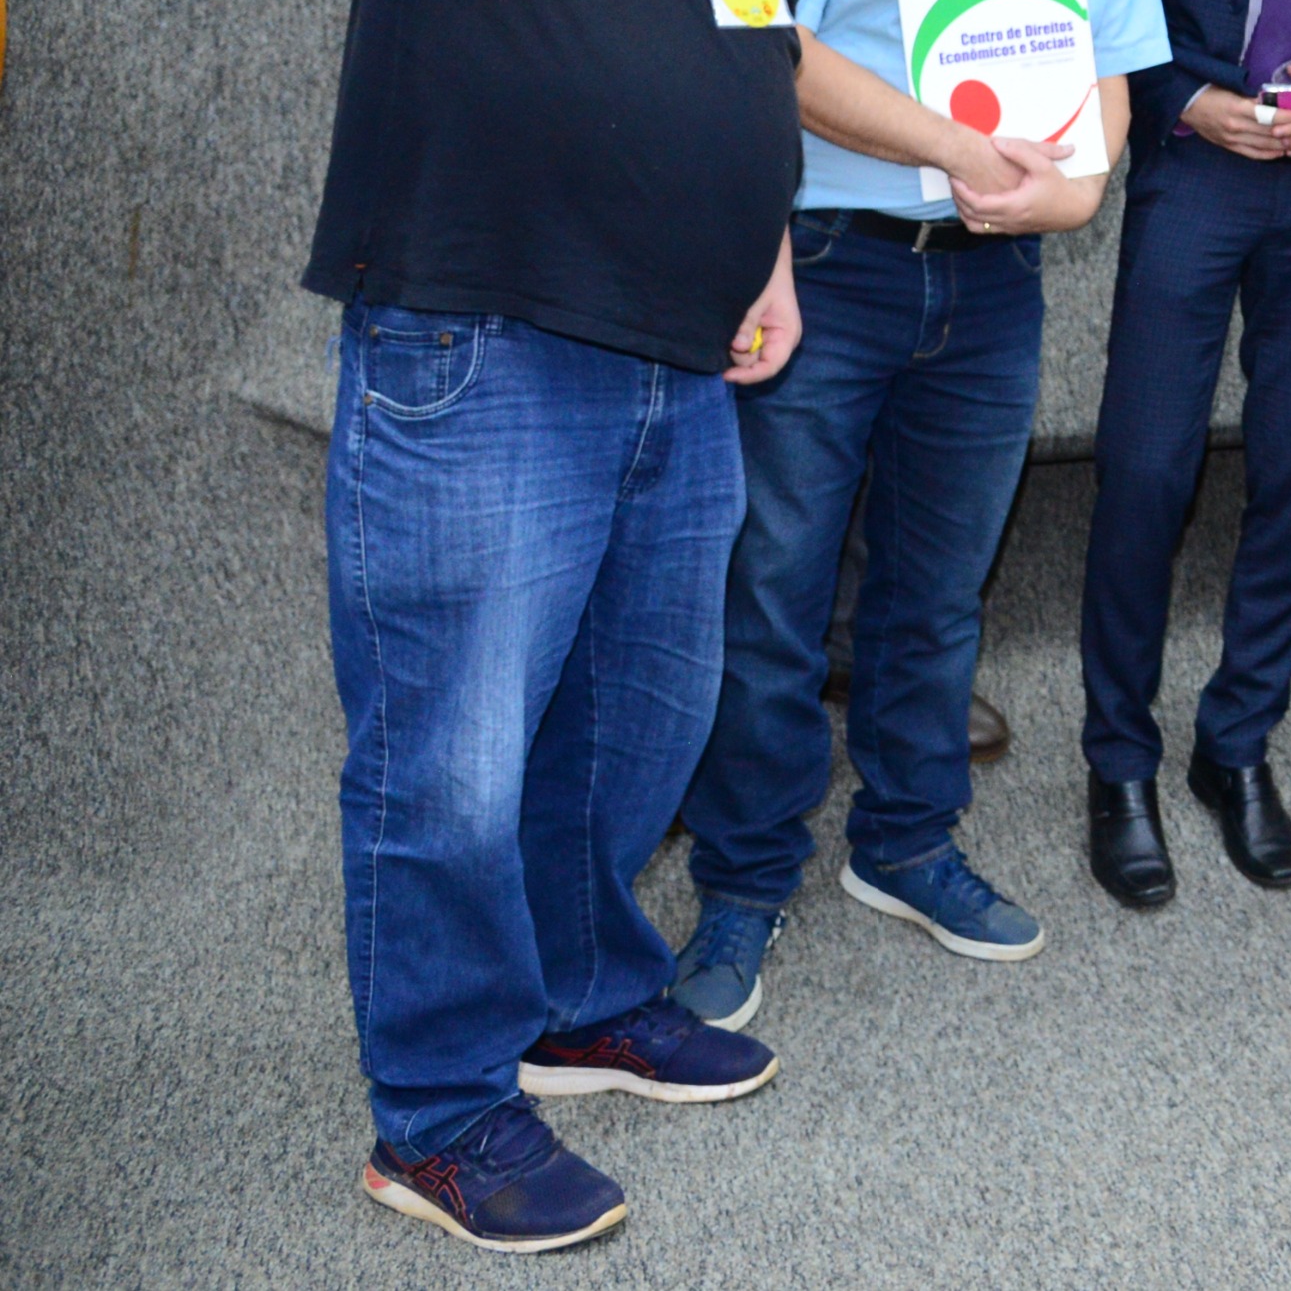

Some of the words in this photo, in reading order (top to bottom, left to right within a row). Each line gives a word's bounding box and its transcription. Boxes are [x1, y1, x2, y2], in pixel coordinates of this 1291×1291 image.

[961, 29, 1003, 46] Centro
[1006, 26, 1022, 40] de
[1025, 21, 1073, 37] Direitos
[939, 43, 1016, 66] Econômicos
[1019, 43, 1026, 54] e
[1030, 35, 1075, 53] Sociais
